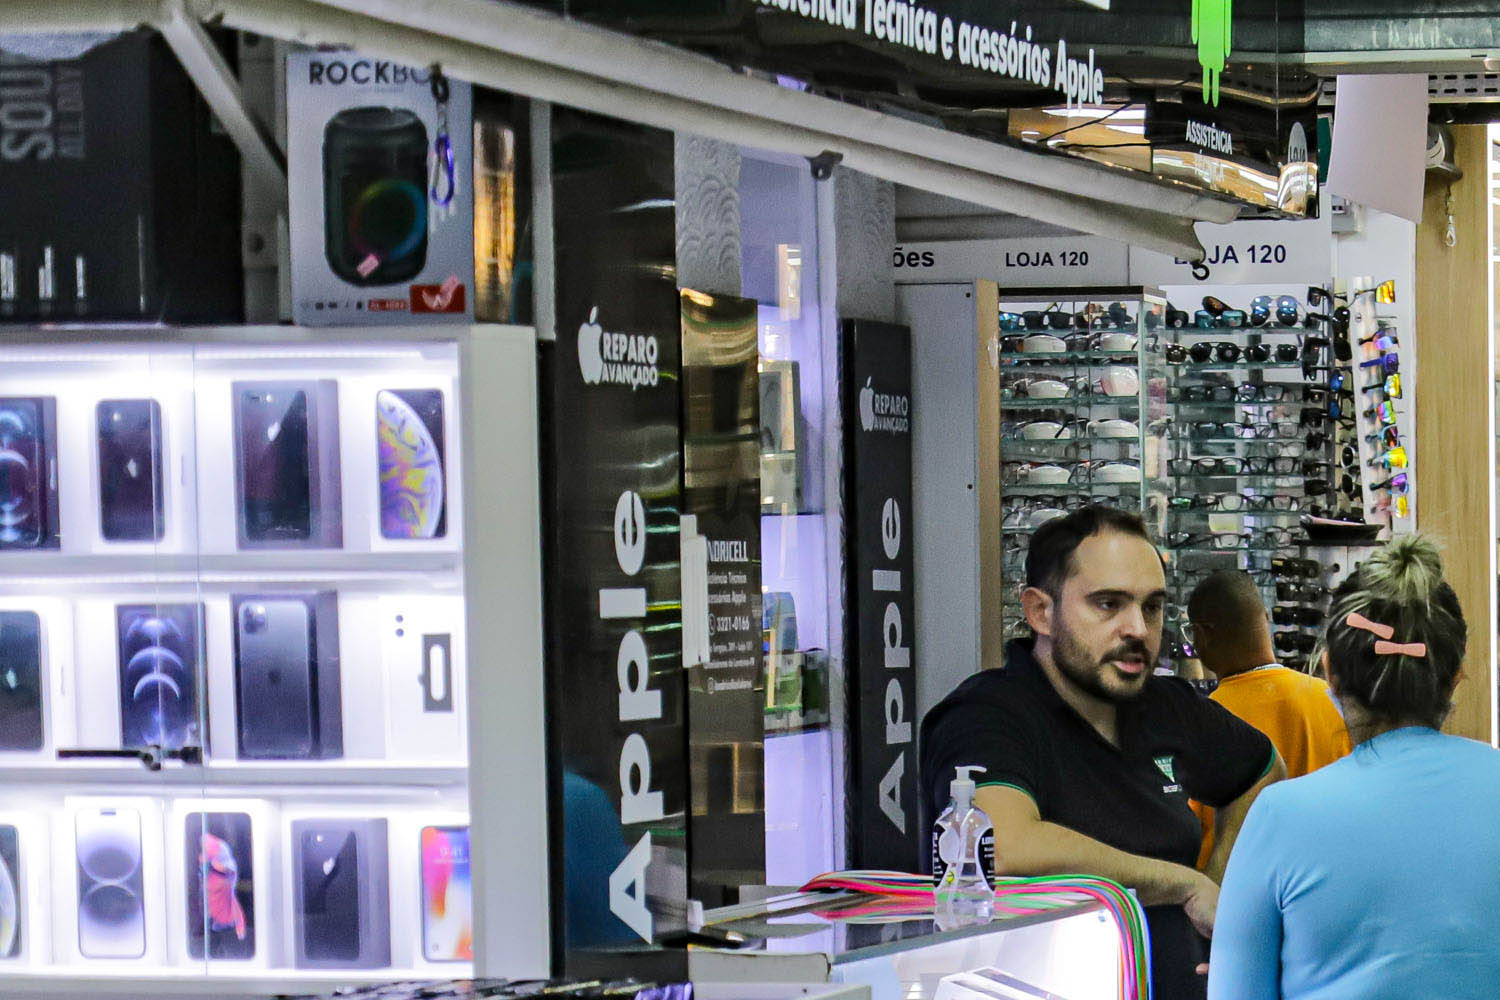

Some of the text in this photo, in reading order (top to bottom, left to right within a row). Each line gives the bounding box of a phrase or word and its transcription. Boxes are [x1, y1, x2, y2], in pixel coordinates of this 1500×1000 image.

[309, 61, 432, 85] ROCKBO
[940, 17, 954, 60] e
[958, 20, 1051, 87] acessórios
[1054, 39, 1104, 112] Apple
[1185, 120, 1233, 155] ASSISTÊNCIA
[1004, 251, 1089, 268] LOJA 120
[1246, 244, 1287, 264] 120
[602, 332, 659, 365] REPARO
[601, 363, 659, 392] AVANÇADO
[874, 394, 909, 417] REPARO
[873, 416, 909, 437] AVANÇADO
[872, 497, 912, 835] Apple
[599, 490, 664, 945] Apple
